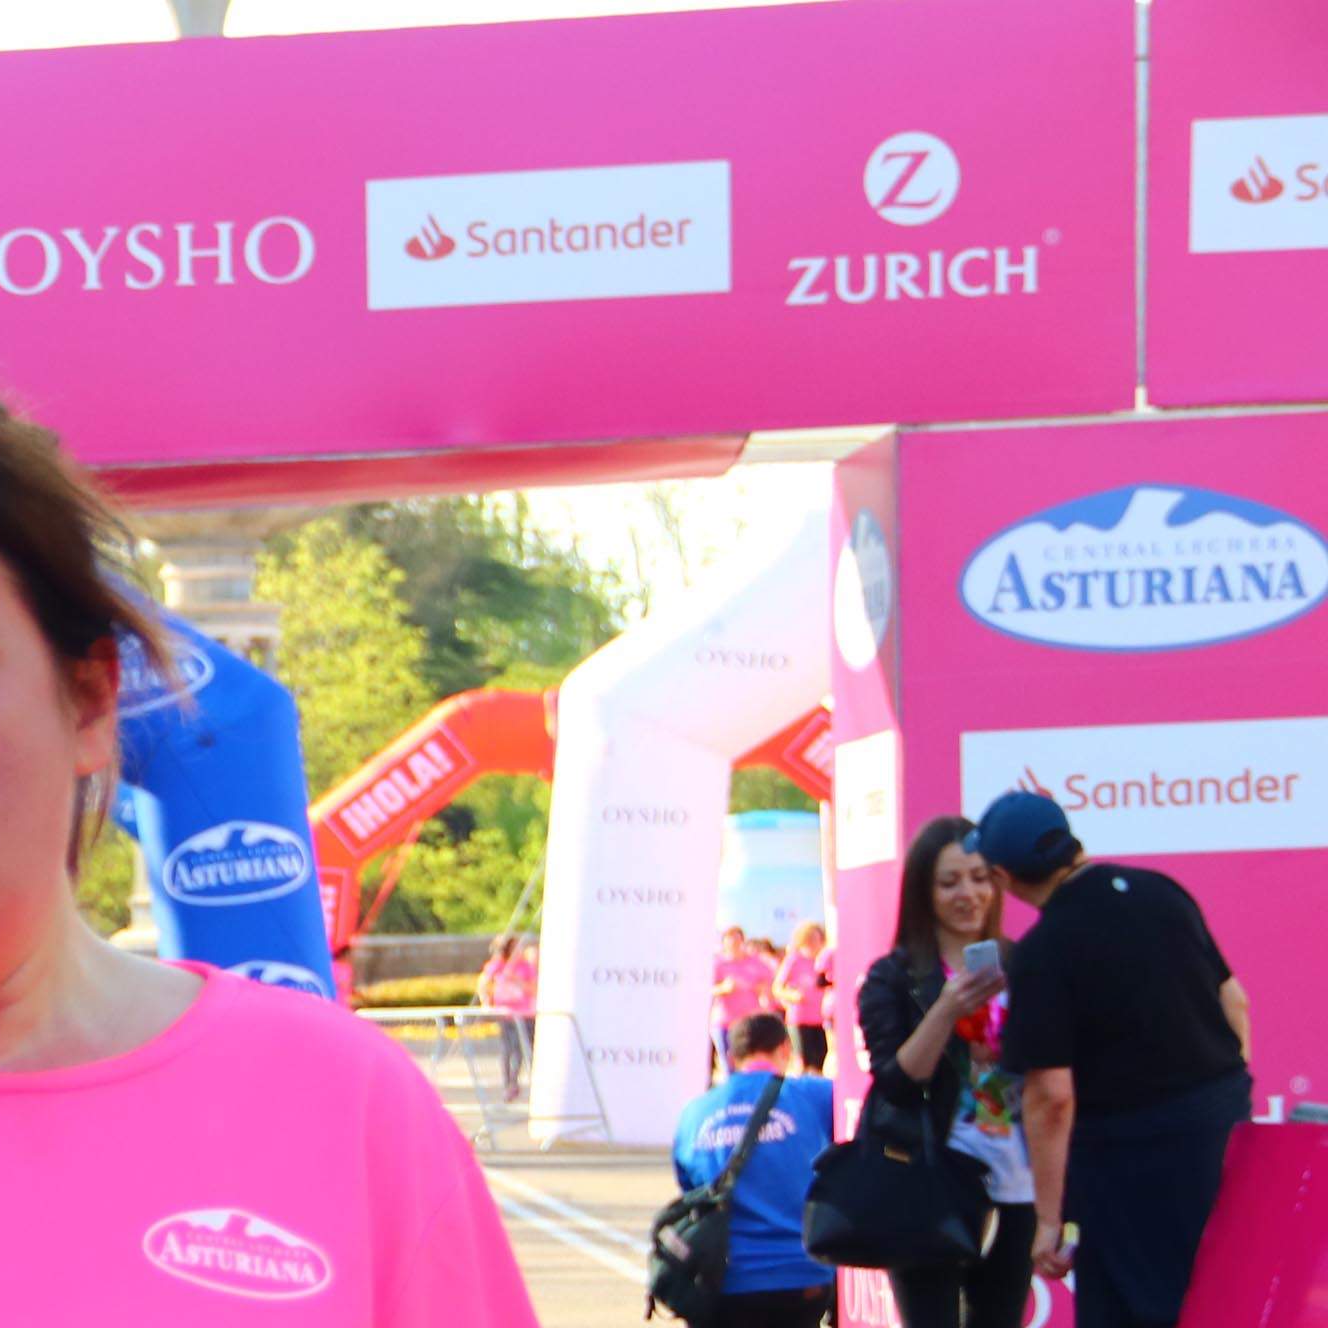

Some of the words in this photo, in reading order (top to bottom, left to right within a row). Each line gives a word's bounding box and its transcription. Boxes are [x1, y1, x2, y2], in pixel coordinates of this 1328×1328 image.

[1295, 161, 1328, 203] S
[465, 208, 694, 260] Santander
[785, 245, 1041, 307] ZURICH
[1043, 539, 1161, 561] CENTRAL
[1174, 533, 1299, 555] LECHERA
[987, 550, 1310, 614] ASTURIANA
[694, 648, 792, 672] OYSHO
[1063, 767, 1301, 811] Santander
[601, 806, 689, 826] OYSHO
[173, 853, 303, 893] ASTURIANA
[596, 886, 687, 906] OYSHO
[591, 967, 681, 987] OYSHO
[586, 1047, 678, 1068] OYSHO
[159, 1231, 317, 1284] ASTURIANA
